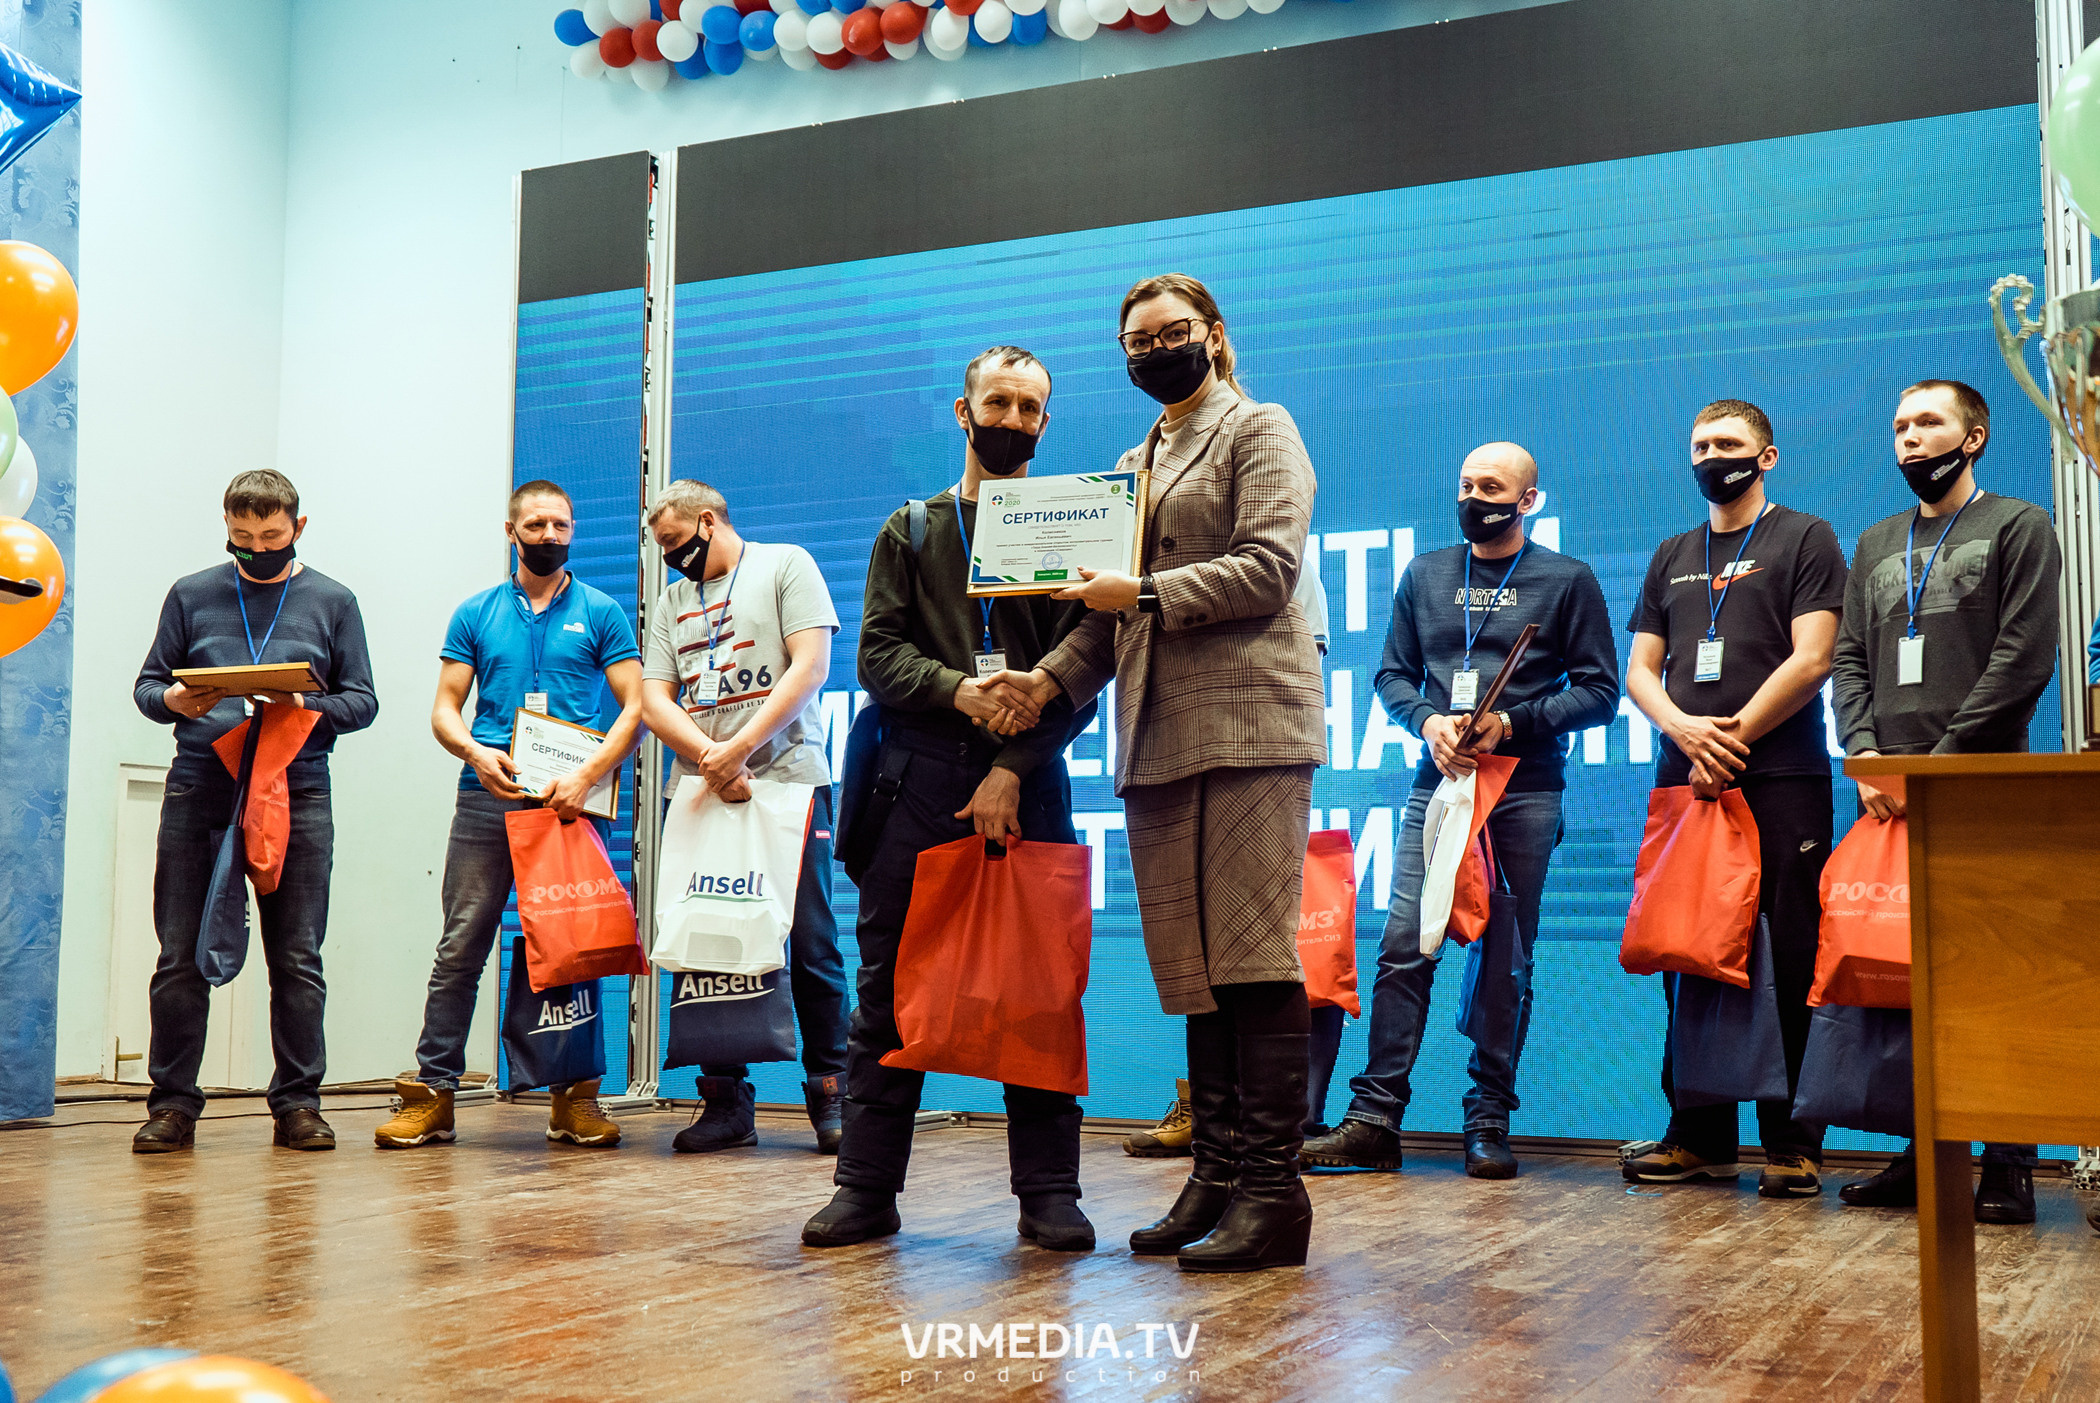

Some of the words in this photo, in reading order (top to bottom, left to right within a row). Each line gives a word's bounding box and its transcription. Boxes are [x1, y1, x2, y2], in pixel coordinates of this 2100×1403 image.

[1003, 508, 1109, 525] СЕРТИФИКАТ
[1720, 560, 1756, 578] NIKE
[531, 743, 587, 765] СЕРТИФИК
[686, 871, 764, 897] Ansell
[1324, 934, 1341, 942] СИЗ
[678, 974, 764, 999] Ansell
[1854, 971, 1911, 982] www.rosom
[538, 989, 593, 1027] Ansell
